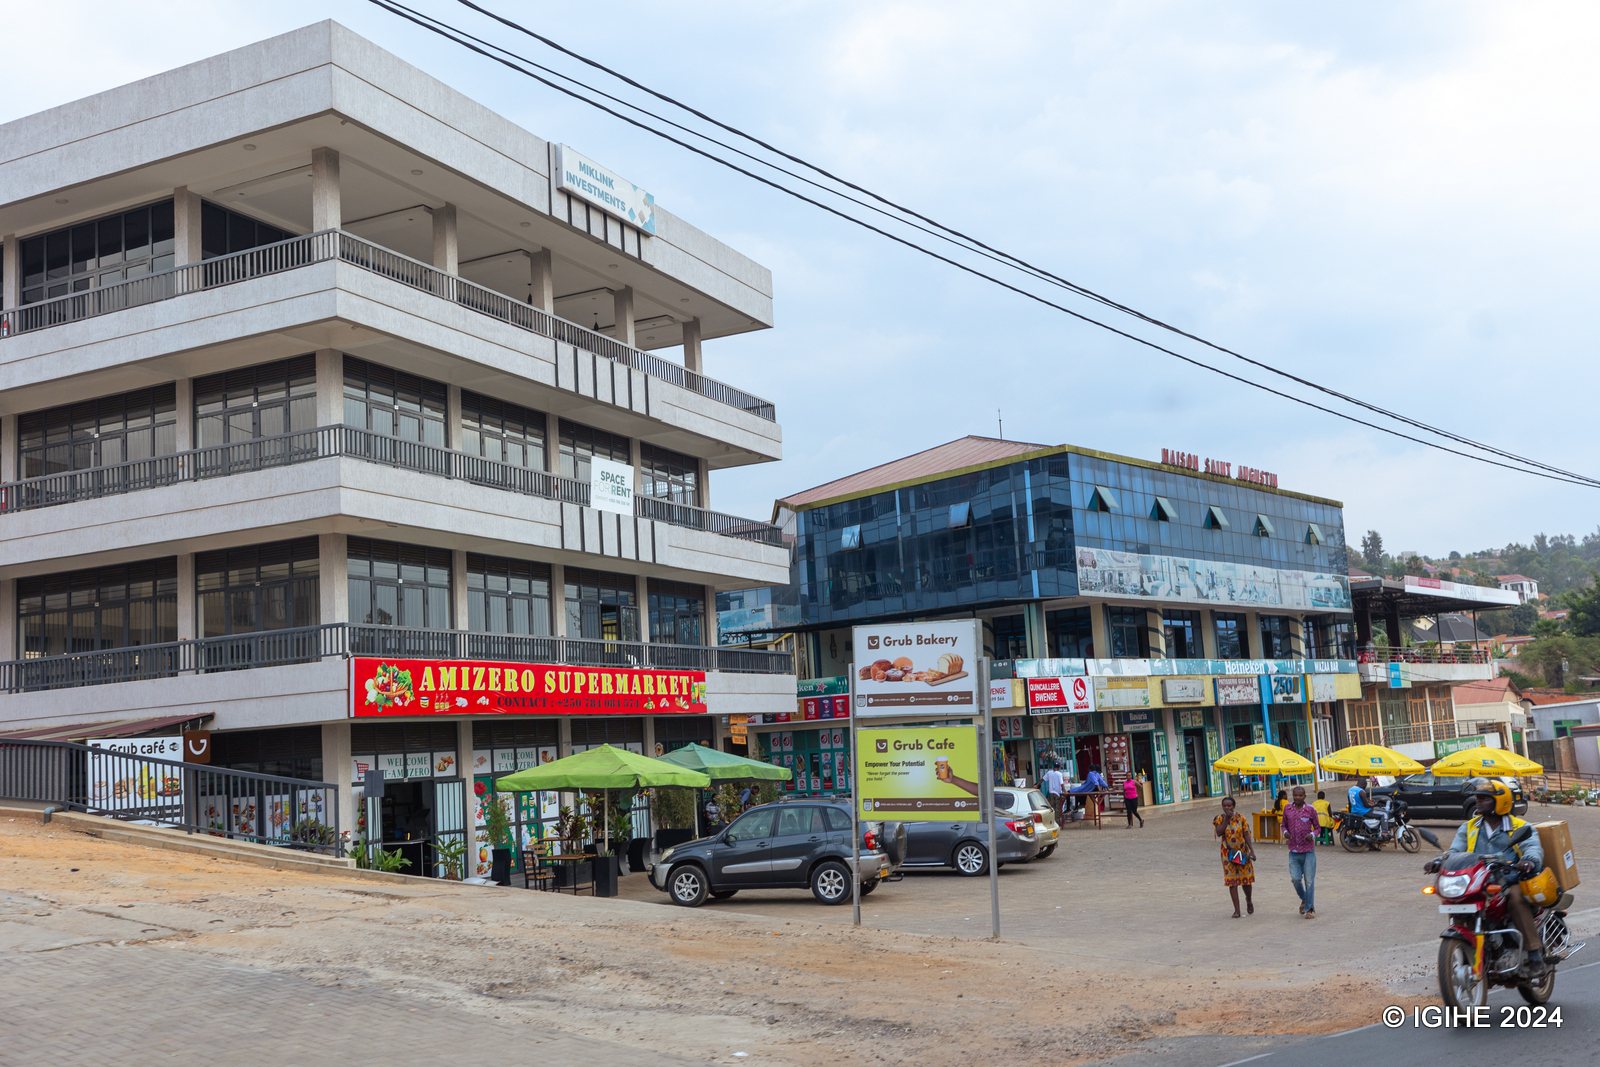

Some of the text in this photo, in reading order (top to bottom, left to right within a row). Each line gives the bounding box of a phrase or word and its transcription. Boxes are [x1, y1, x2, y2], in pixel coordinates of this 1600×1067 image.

[579, 161, 614, 190] MIKLINK
[566, 171, 626, 212] INVESTMENTS
[1161, 448, 1278, 488] MAISON SAINT AUGUSTIN
[600, 470, 625, 486] SPACE
[594, 480, 631, 498] FOR RENT
[883, 633, 958, 647] Grub Bakery
[1225, 660, 1265, 674] Heineken
[1330, 661, 1339, 672] BAR
[419, 666, 690, 695] AMIZERO SUPERMARKET
[1030, 682, 1060, 692] QUINCAILLERIE
[497, 696, 548, 707] CONTACT
[557, 698, 581, 708] +250
[585, 699, 601, 708] 784
[604, 699, 621, 708] 084
[623, 699, 640, 708] 574
[1035, 692, 1058, 702] BWENGE
[140, 739, 165, 754] café
[893, 738, 955, 751] Grub Cafe
[387, 756, 428, 767] WELCOME
[500, 751, 534, 760] WELCOME
[864, 761, 889, 769] Empower
